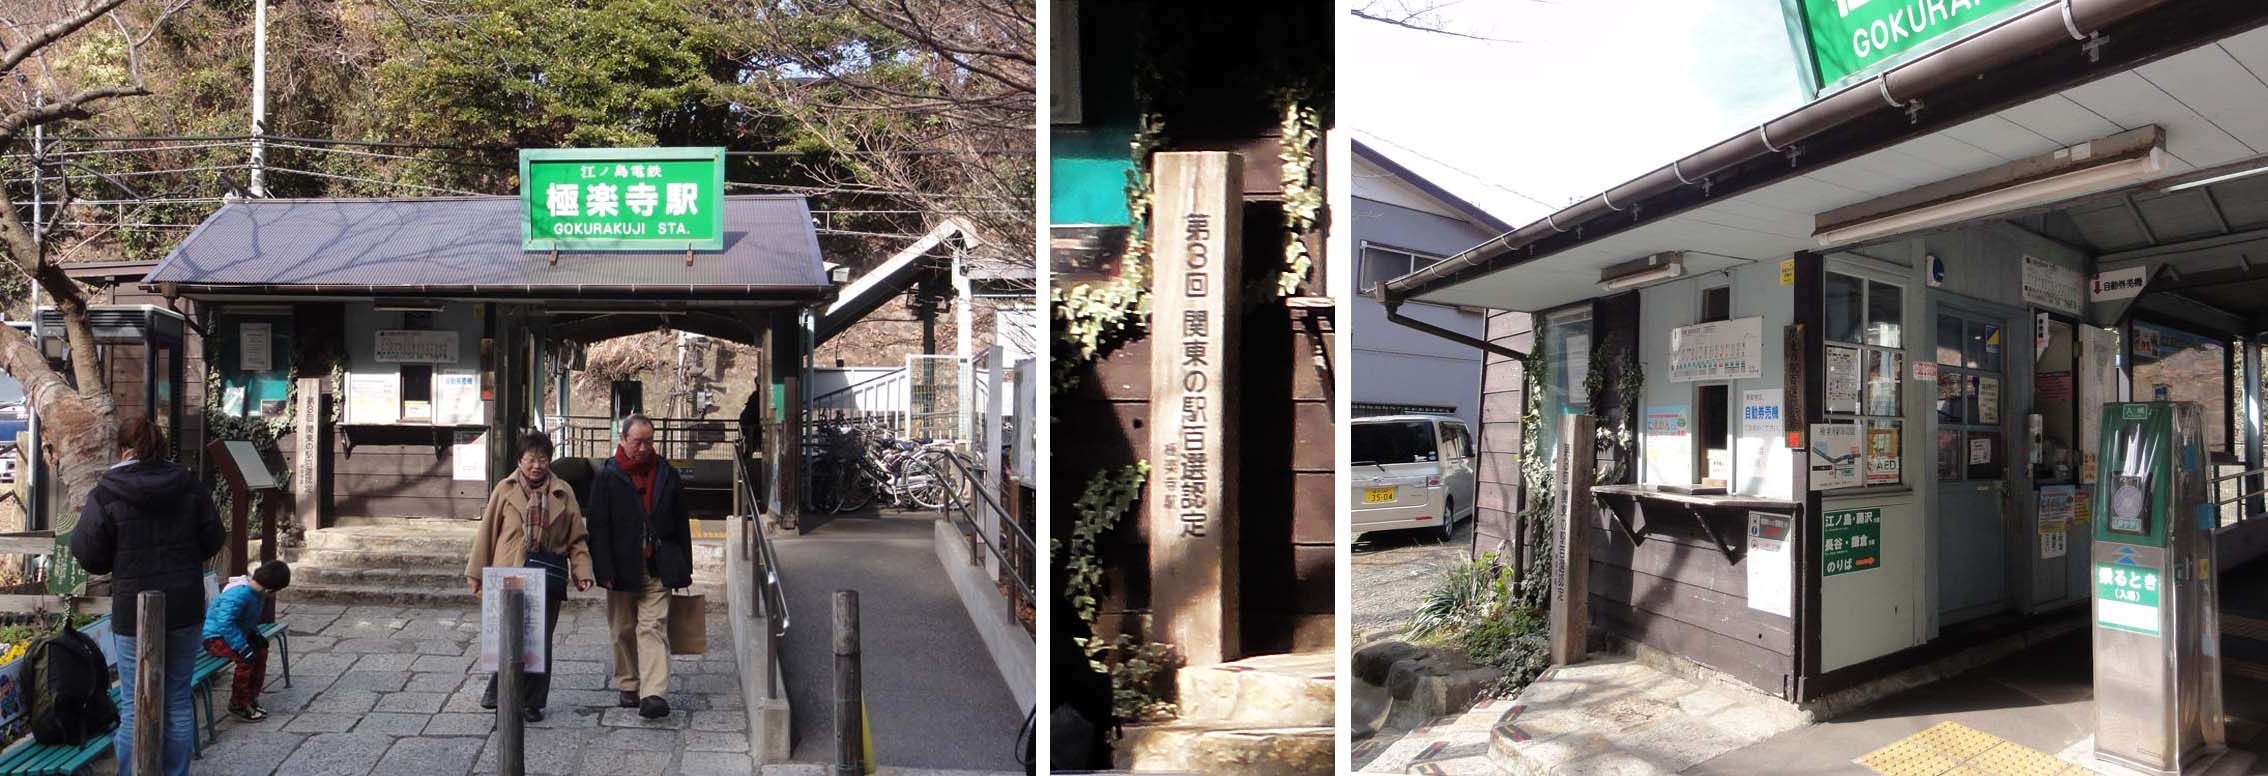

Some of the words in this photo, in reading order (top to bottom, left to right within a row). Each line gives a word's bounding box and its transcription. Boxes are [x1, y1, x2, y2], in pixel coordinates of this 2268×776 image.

[1853, 0, 1981, 57] GOKURA
[580, 165, 663, 179] 江ノ島電鉄
[546, 182, 699, 217] 極楽寺駅
[553, 222, 646, 234] GOKURAKUJI
[657, 222, 691, 234] STA.
[1183, 213, 1211, 298] 第3回
[1180, 310, 1210, 539] 関東の駅百選認定
[1876, 460, 1897, 471] AED
[1826, 558, 1853, 574] のりば
